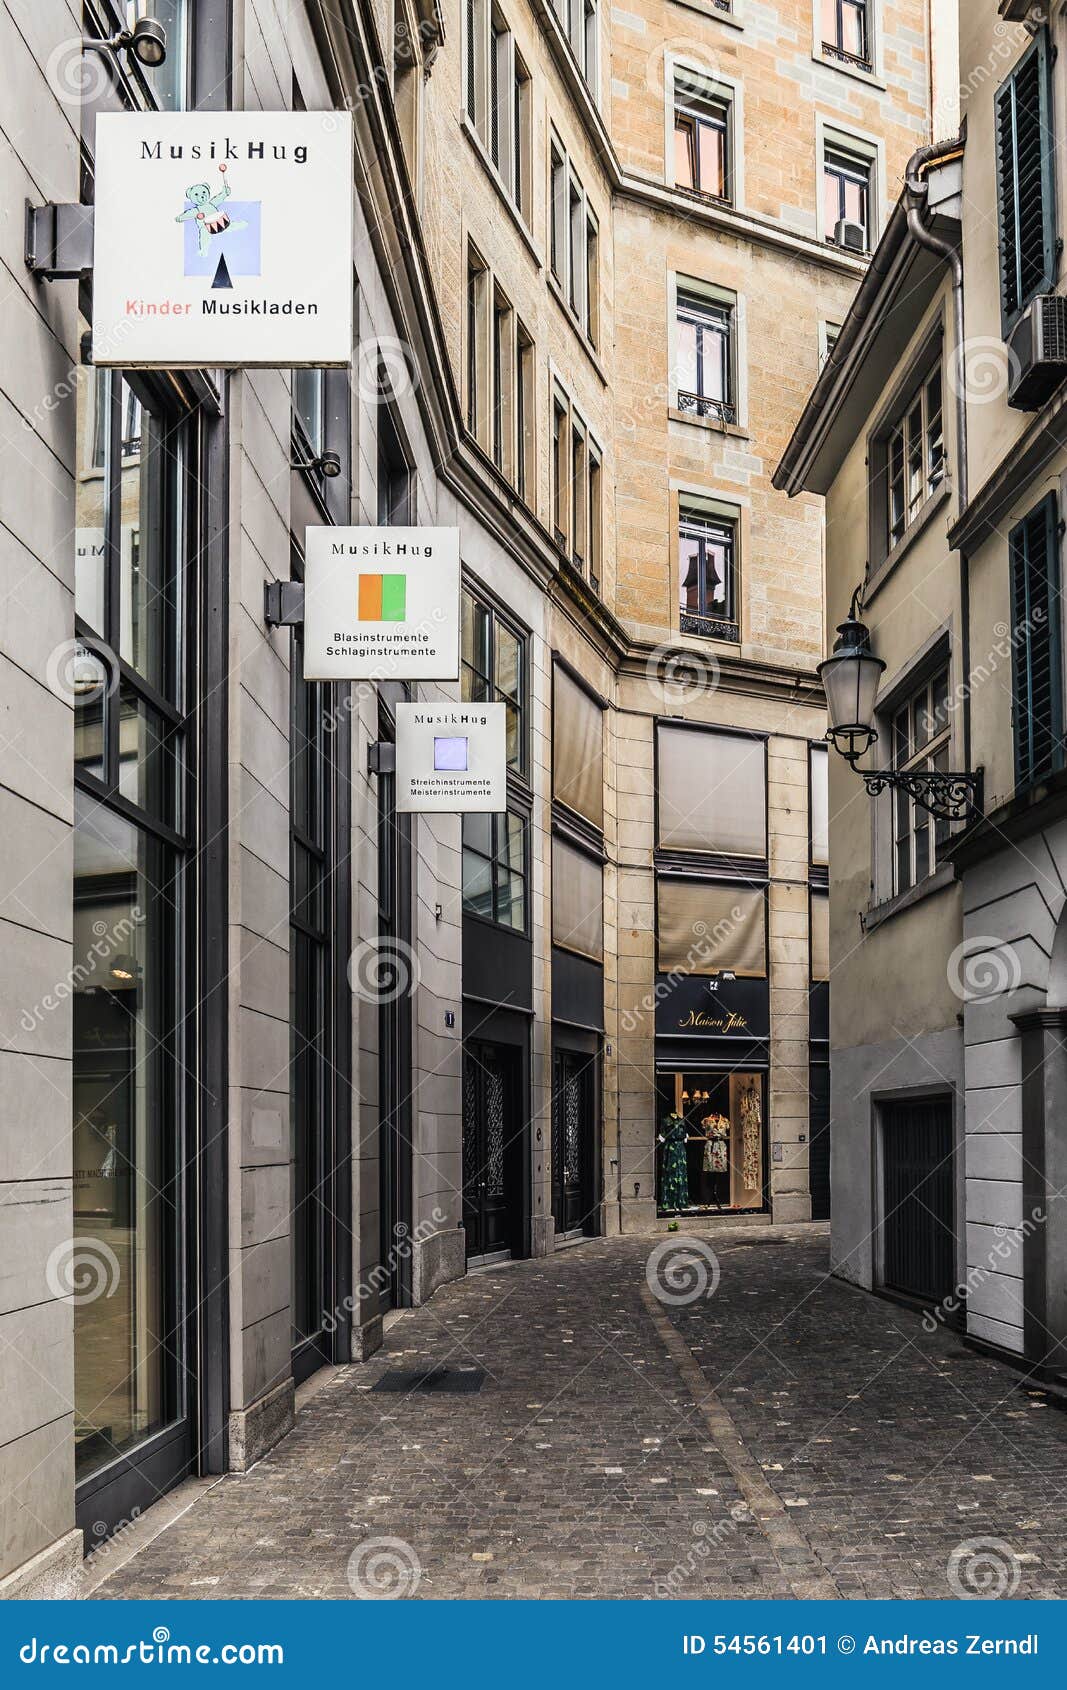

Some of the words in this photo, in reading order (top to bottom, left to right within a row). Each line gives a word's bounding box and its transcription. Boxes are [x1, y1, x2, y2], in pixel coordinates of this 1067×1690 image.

[125, 299, 192, 316] Kinder
[201, 299, 319, 316] Musikladen
[333, 632, 430, 642] Blasinstrumente
[326, 646, 437, 658] Schlaginstrumente
[410, 778, 492, 787] Streichinstrumente
[410, 788, 493, 796] Meisterinstrumente
[678, 1010, 723, 1028] Maison
